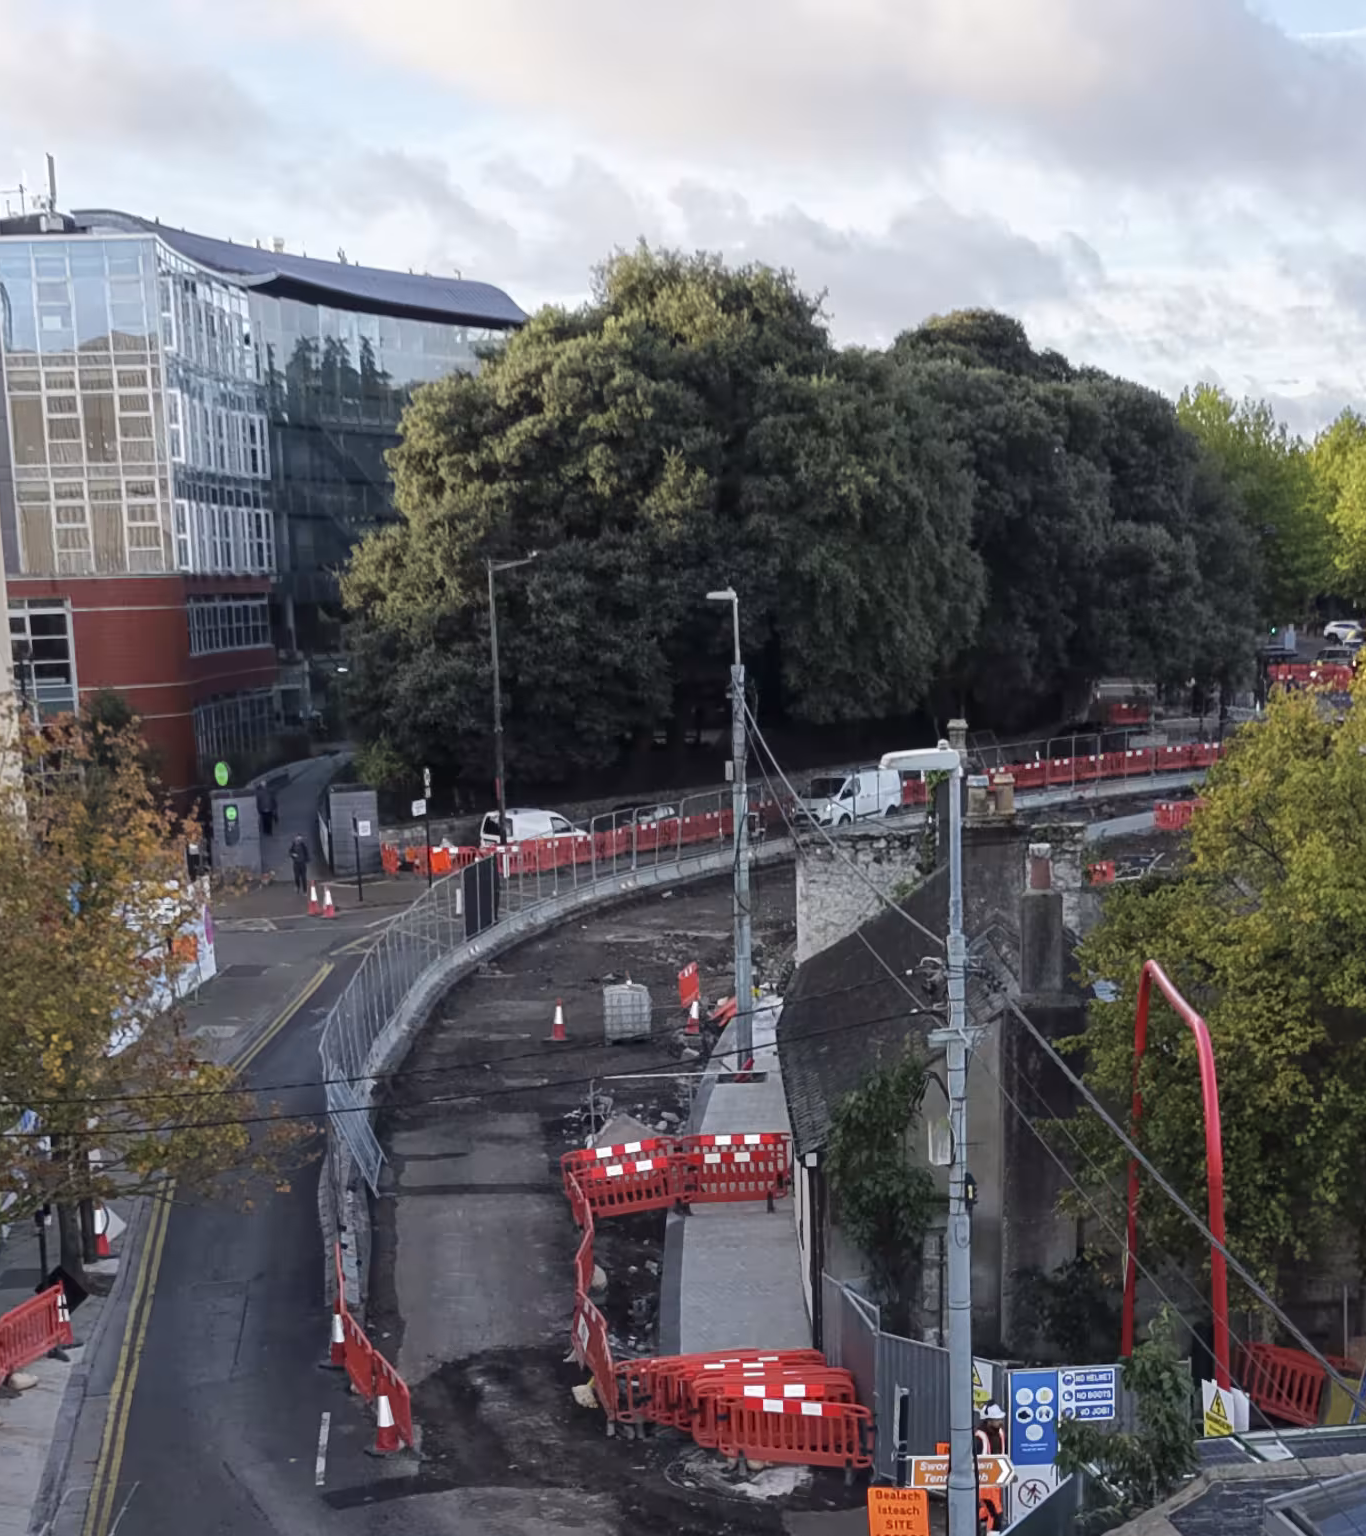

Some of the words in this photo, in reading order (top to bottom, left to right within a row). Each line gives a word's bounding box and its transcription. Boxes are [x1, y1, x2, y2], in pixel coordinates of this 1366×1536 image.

[1087, 1390, 1112, 1399] BOOTS
[875, 1489, 922, 1501] Bealach
[885, 1519, 914, 1530] SITE
